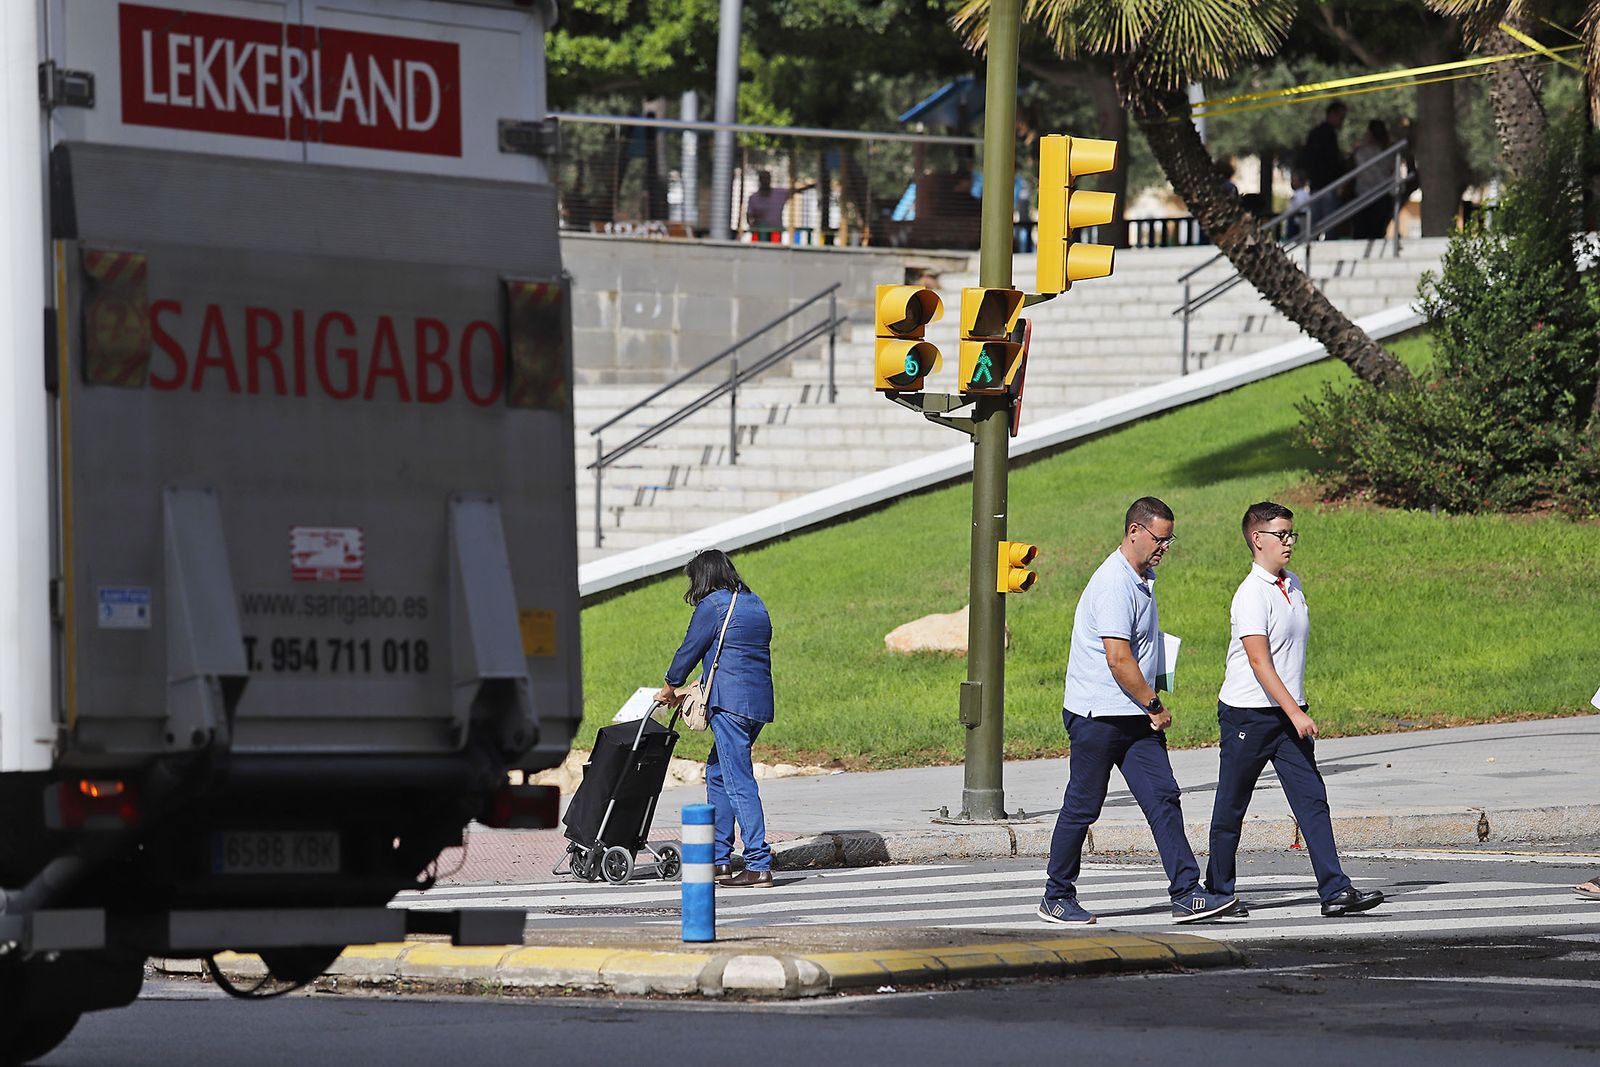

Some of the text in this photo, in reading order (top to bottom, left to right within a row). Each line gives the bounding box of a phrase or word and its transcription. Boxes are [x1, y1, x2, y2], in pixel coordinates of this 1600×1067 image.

[142, 29, 442, 132] LEKKERLAND
[149, 299, 505, 408] SARIGABO
[241, 588, 429, 624] www.sarigabo.es
[243, 635, 430, 674] T. 954 711 018
